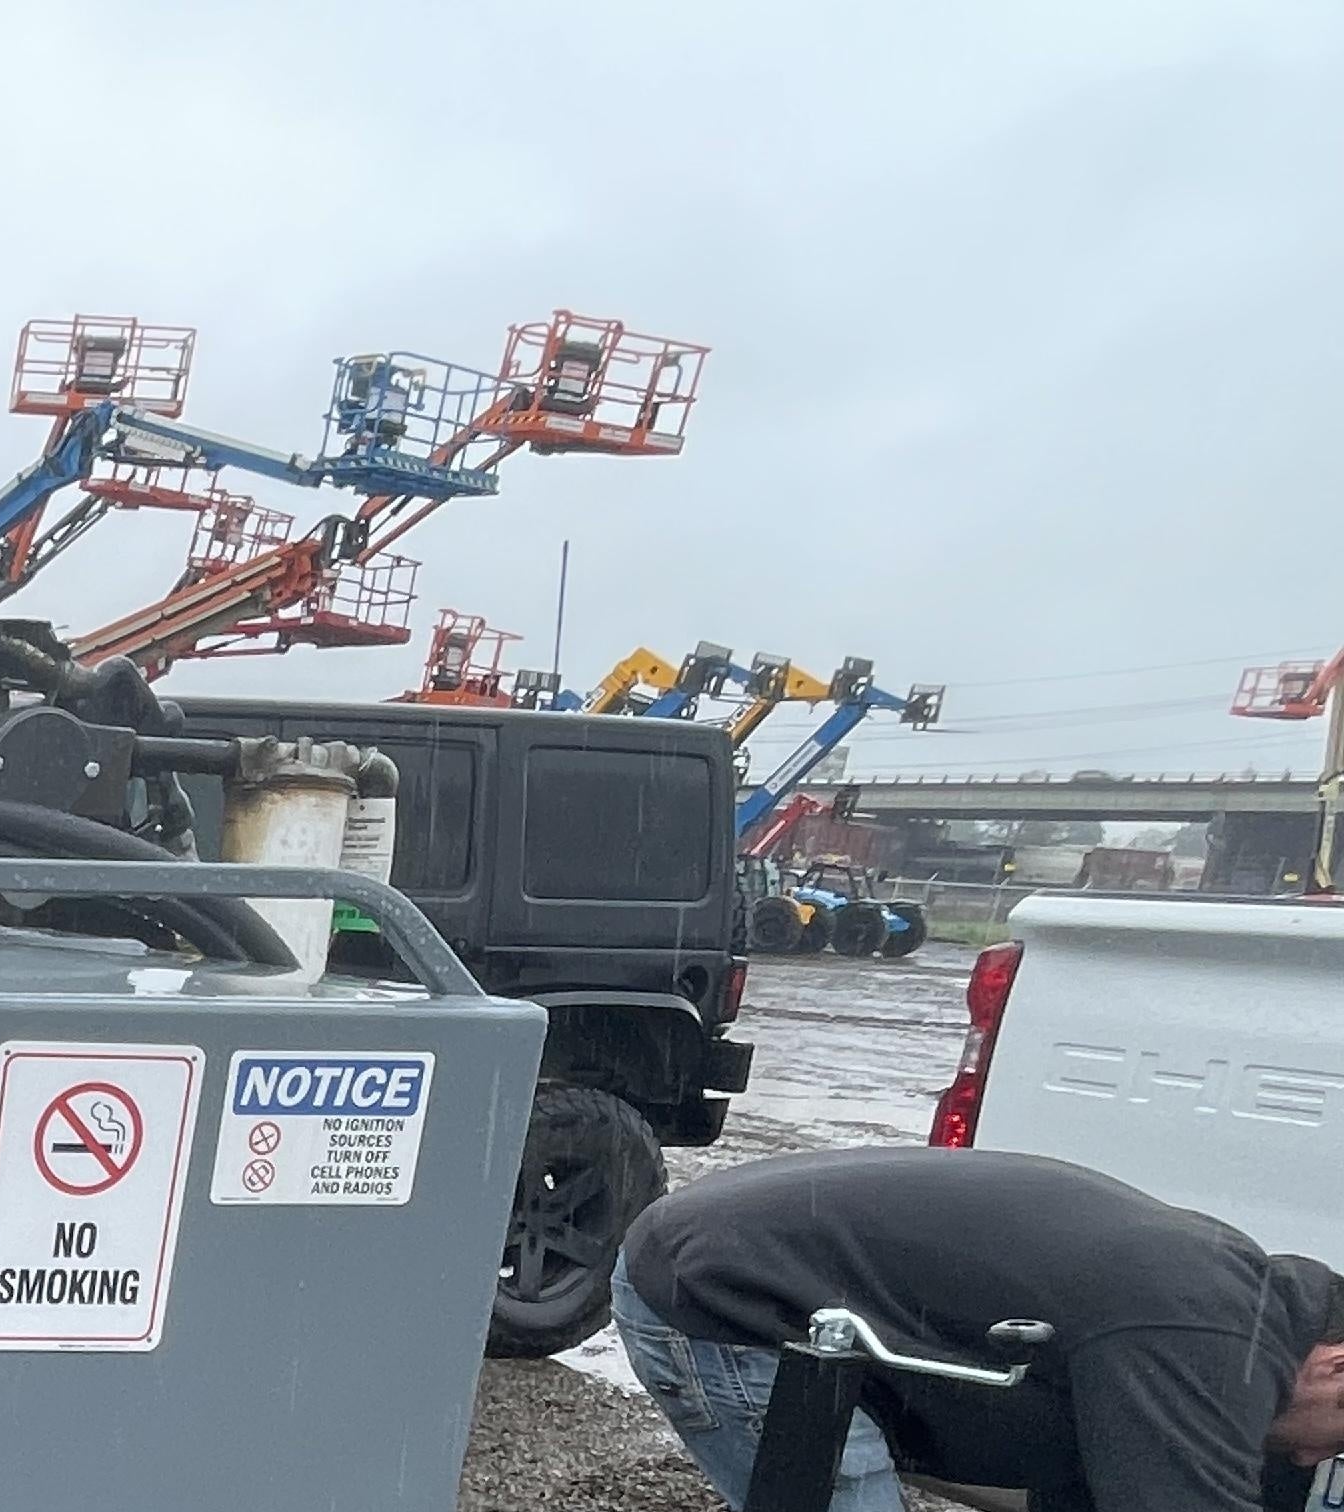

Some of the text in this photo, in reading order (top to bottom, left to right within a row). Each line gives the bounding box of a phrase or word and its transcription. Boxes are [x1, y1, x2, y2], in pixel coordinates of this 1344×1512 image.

[239, 1066, 420, 1108] NOTICE
[322, 1118, 405, 1132] NO IGNITION
[329, 1134, 392, 1148] SOURCES
[327, 1150, 390, 1163] TURN OFF
[310, 1166, 400, 1179] CELL PHONES
[311, 1182, 393, 1195] AND RADIOS
[53, 1222, 98, 1259] NO
